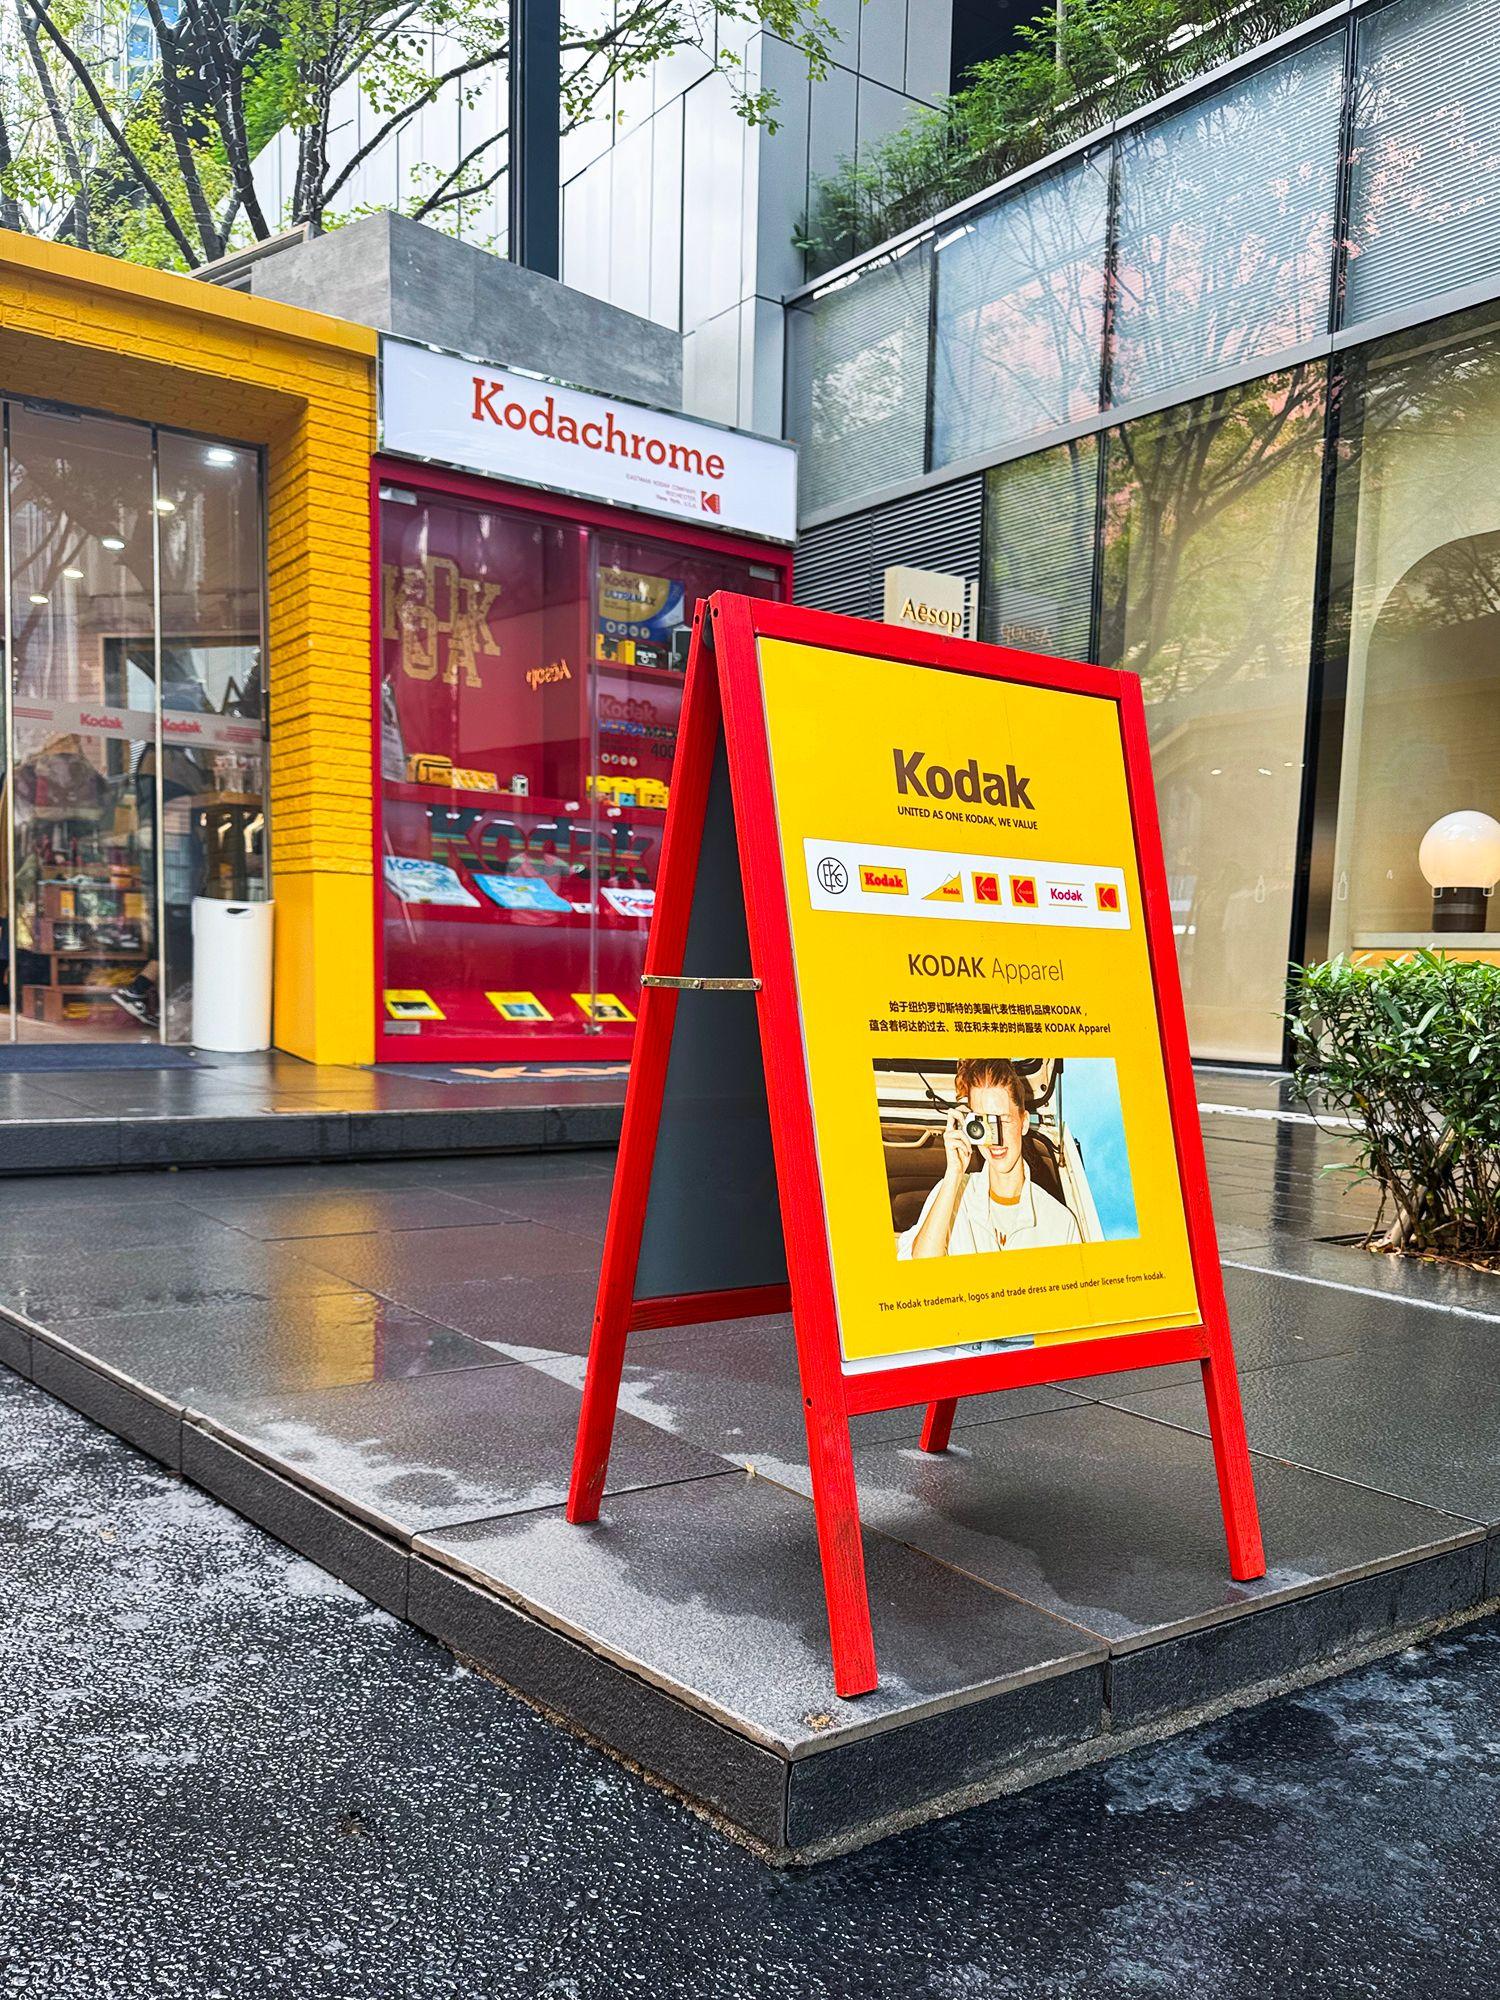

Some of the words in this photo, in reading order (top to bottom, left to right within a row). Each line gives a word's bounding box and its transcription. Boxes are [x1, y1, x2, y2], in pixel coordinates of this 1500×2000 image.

[472, 377, 725, 479] Kodachrome
[901, 598, 963, 634] Aēsop
[80, 712, 123, 730] Kodak
[892, 748, 1036, 811] Kodak
[897, 805, 931, 818] UNITED
[933, 810, 944, 820] AS
[945, 811, 964, 822] ONE
[965, 813, 997, 827] KODAK,
[998, 817, 1012, 828] WE
[1013, 818, 1039, 830] VALUE
[864, 872, 904, 889] Kodak
[942, 887, 961, 896] Kodak
[1050, 887, 1083, 902] Kodak
[908, 953, 986, 979] KODAK
[991, 957, 1065, 985] Apparel
[1044, 1022, 1076, 1034] KODAK
[1078, 1023, 1111, 1036] Apparel
[878, 1302, 895, 1313] The
[896, 1299, 922, 1310] Kodak
[923, 1294, 967, 1308] trademark,
[967, 1292, 989, 1304] logos
[990, 1289, 1005, 1300] and
[1006, 1287, 1026, 1297] trade
[1027, 1284, 1047, 1295] dress
[1048, 1284, 1060, 1293] are
[1061, 1280, 1079, 1291] used
[1080, 1278, 1100, 1289] under
[1101, 1276, 1125, 1287] license
[1125, 1274, 1142, 1284] from
[1143, 1271, 1166, 1282] kodak.
